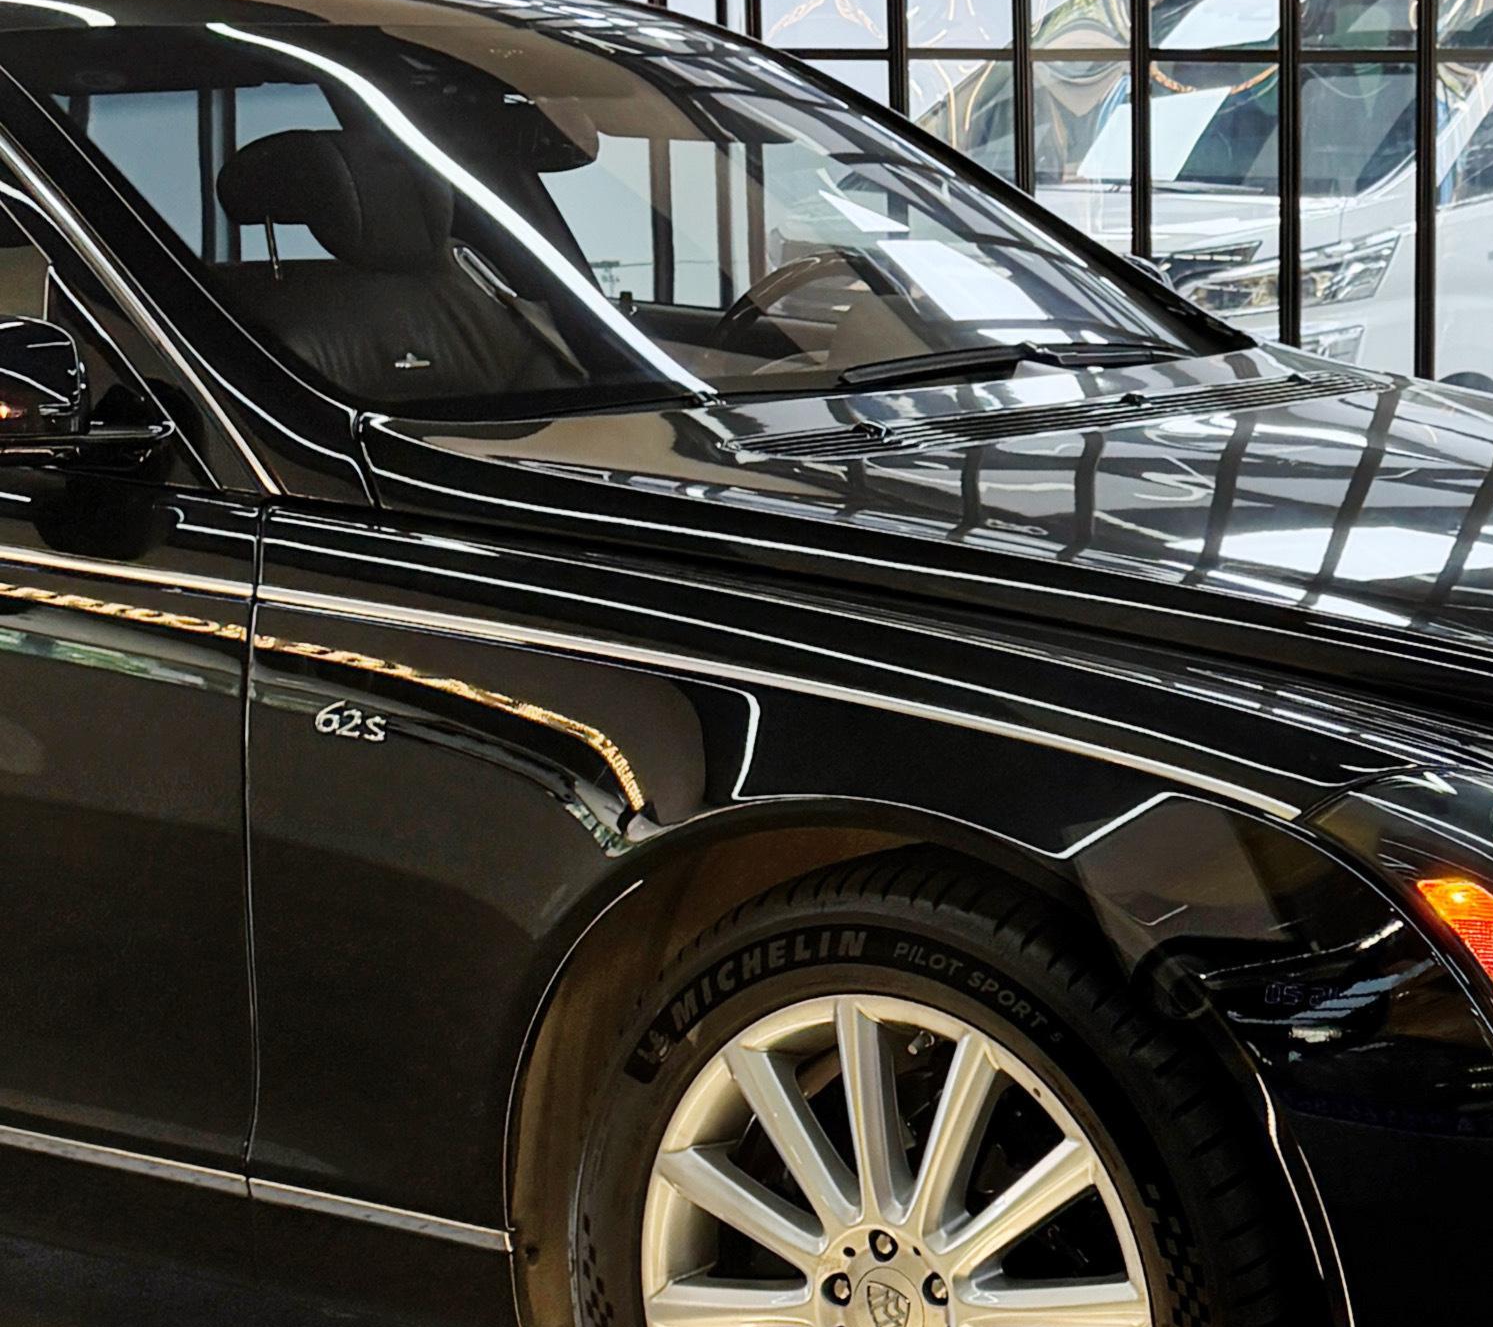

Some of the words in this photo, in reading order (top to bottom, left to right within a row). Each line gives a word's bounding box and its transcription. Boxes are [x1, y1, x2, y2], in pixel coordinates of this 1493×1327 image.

[670, 929, 868, 1032] MICHELIN
[892, 941, 965, 977] PILOT
[967, 970, 1049, 1032] SPORT
